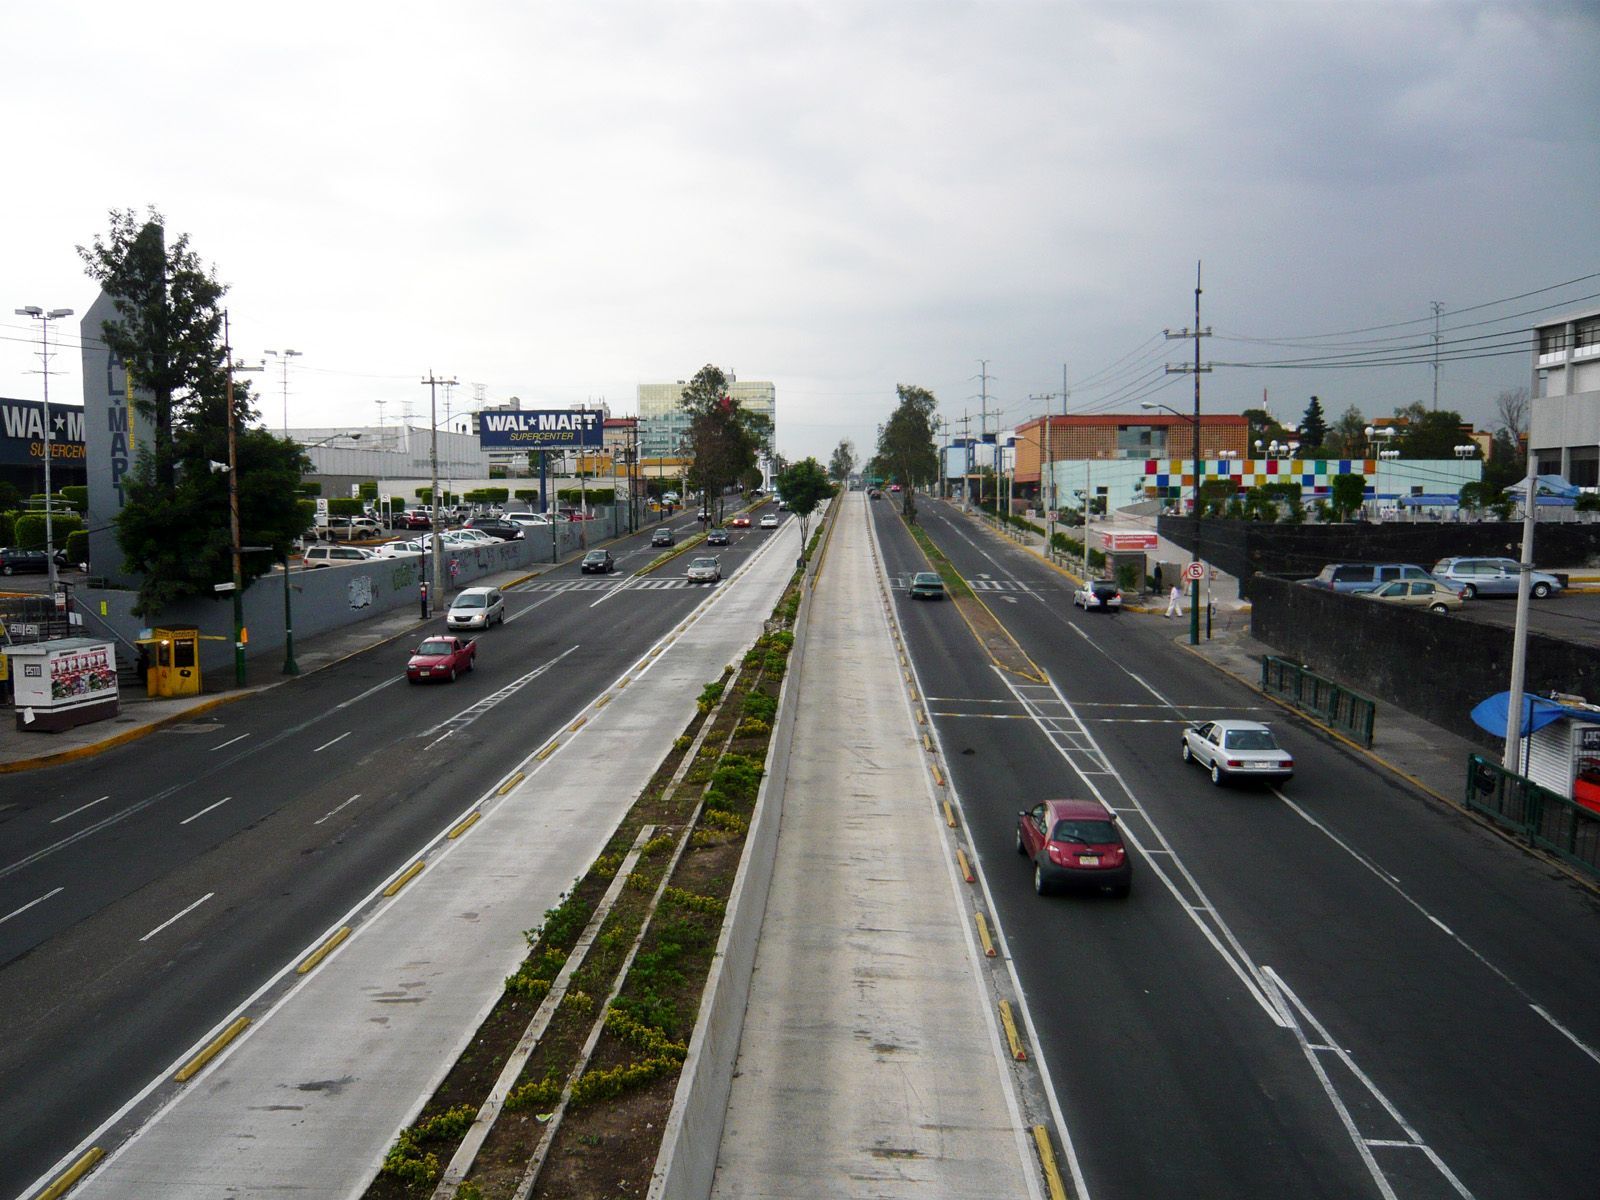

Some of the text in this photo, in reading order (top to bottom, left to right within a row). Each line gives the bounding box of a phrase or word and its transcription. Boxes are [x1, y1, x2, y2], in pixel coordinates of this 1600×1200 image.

[2, 405, 56, 440] WAL
[485, 414, 596, 431] WAL MART
[509, 432, 574, 441] SUPERCENTER
